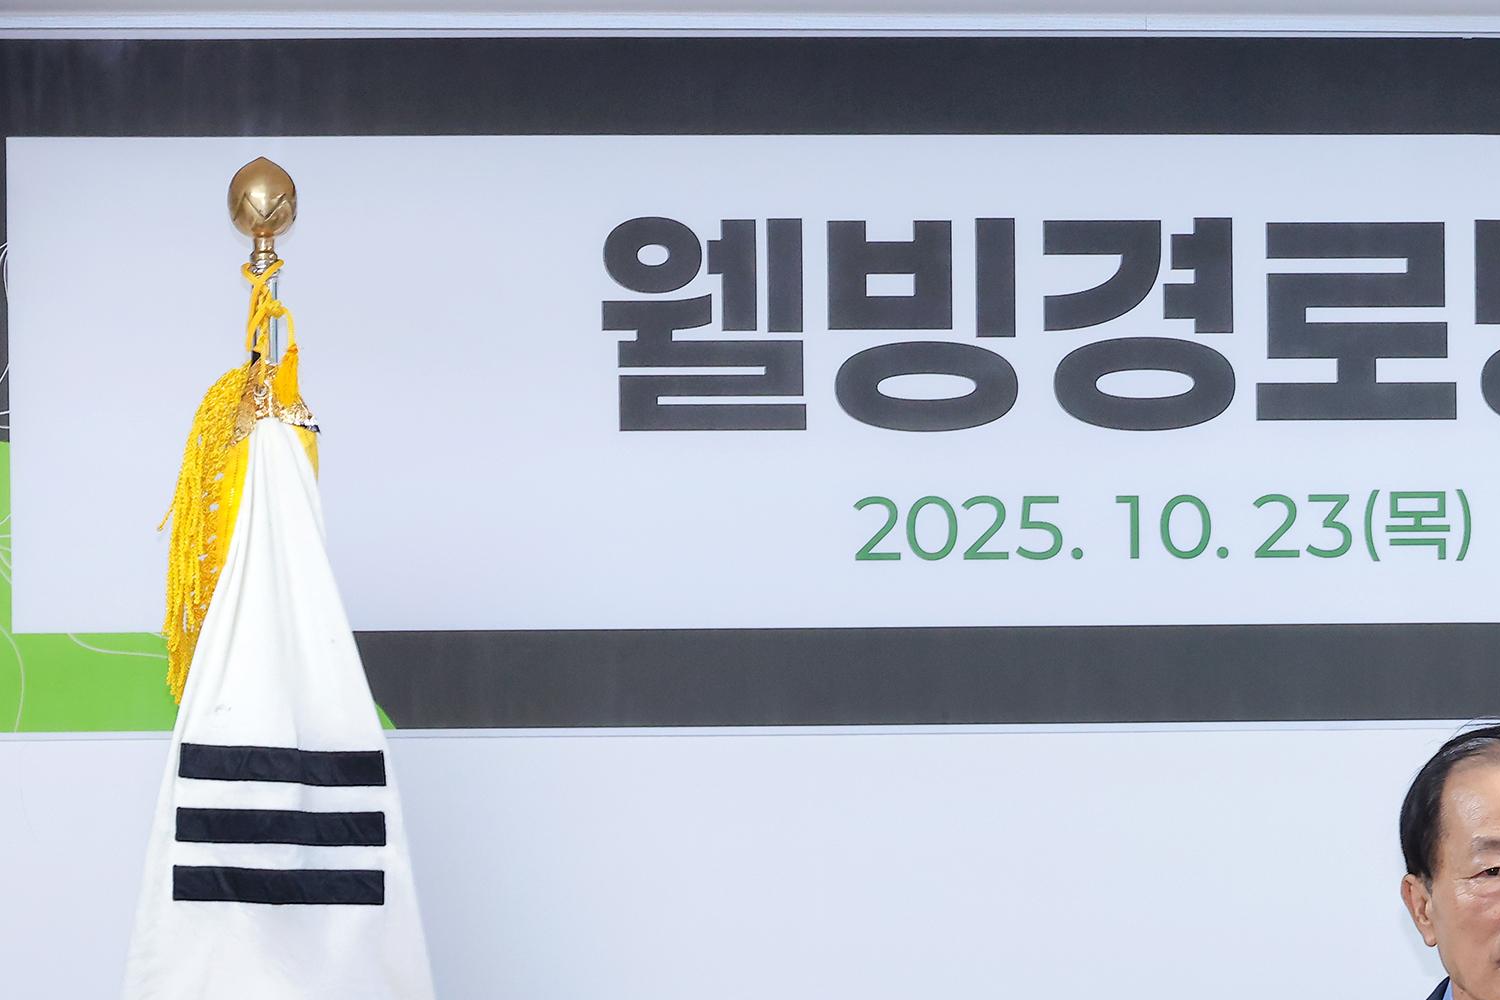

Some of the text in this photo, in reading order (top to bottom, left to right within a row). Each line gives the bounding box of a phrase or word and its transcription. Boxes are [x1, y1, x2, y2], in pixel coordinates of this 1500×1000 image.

[853, 495, 1084, 562] 2025.
[1115, 494, 1230, 560] 10.
[1252, 488, 1472, 562] 23(목)
